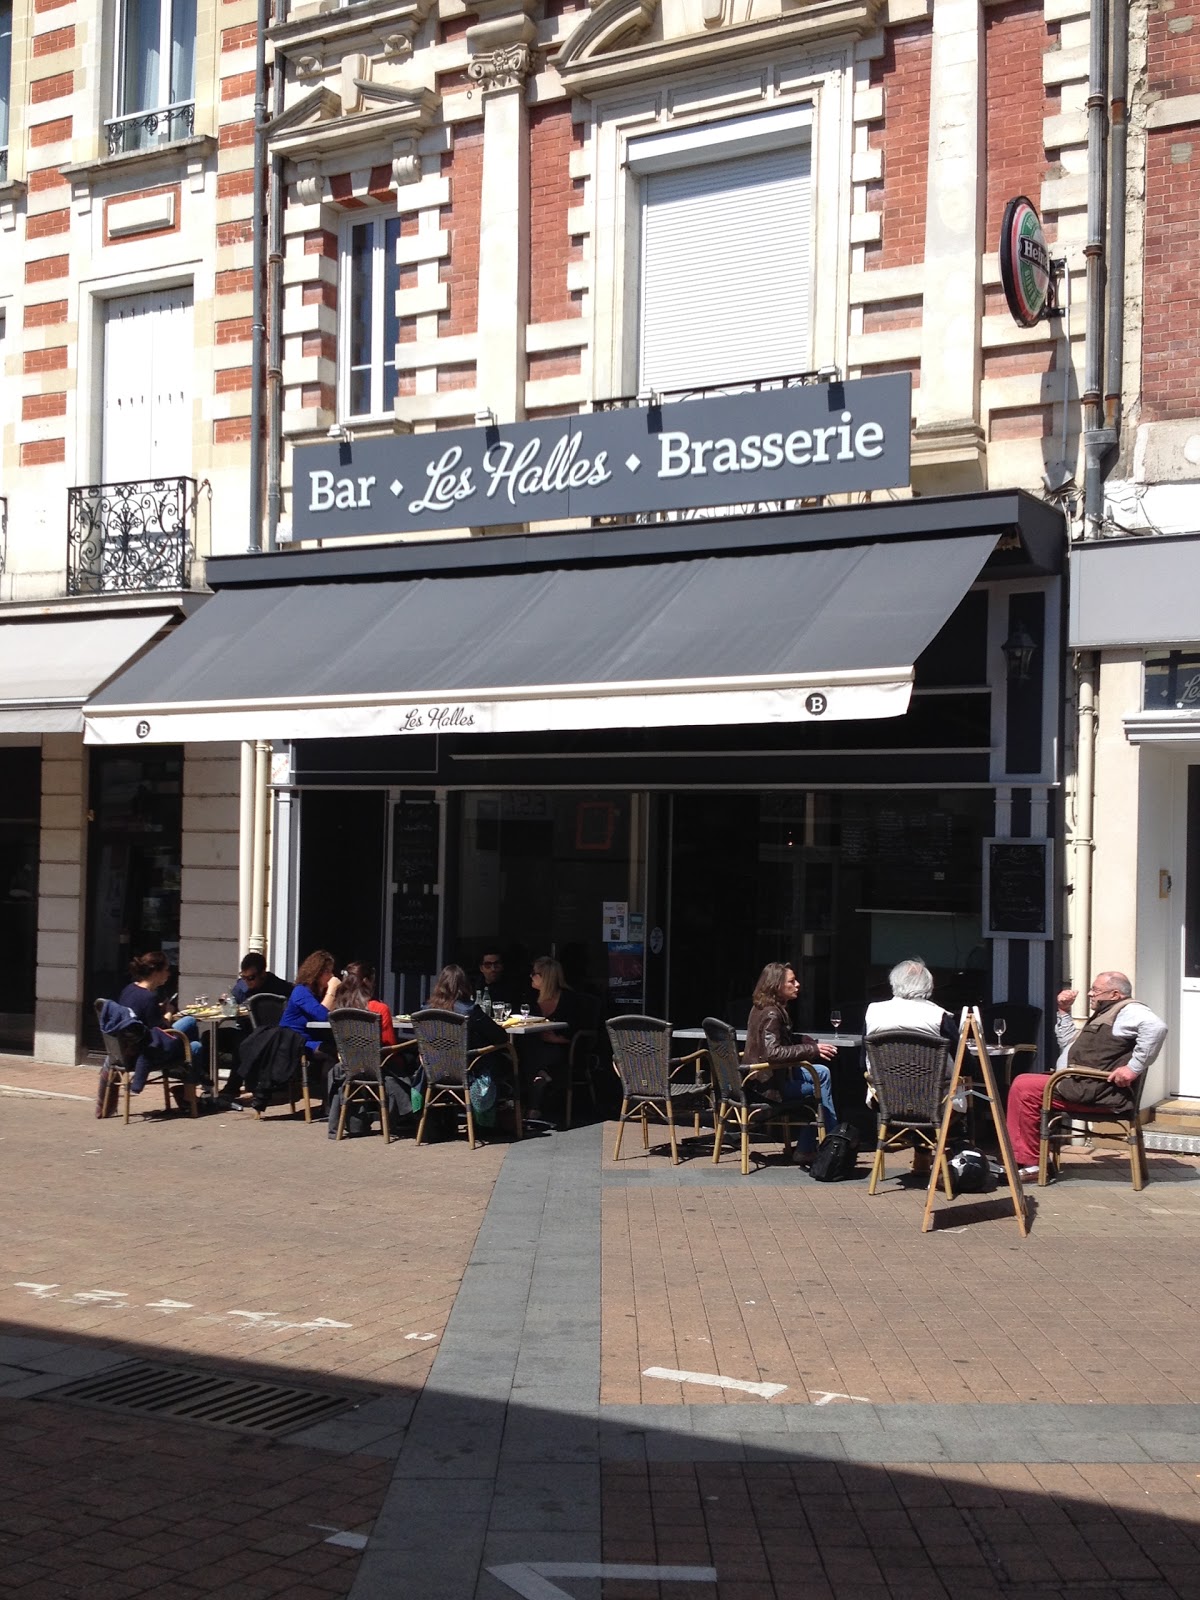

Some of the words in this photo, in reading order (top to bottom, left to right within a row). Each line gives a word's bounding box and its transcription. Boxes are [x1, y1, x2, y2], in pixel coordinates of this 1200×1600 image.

[308, 470, 376, 511] Bar
[408, 446, 476, 513] Les
[482, 430, 612, 505] Halles
[657, 411, 883, 478] Brasserie
[1176, 674, 1200, 703] Le
[809, 695, 824, 713] B
[138, 722, 149, 737] B
[399, 708, 423, 731] Les
[428, 707, 475, 729] Halles
